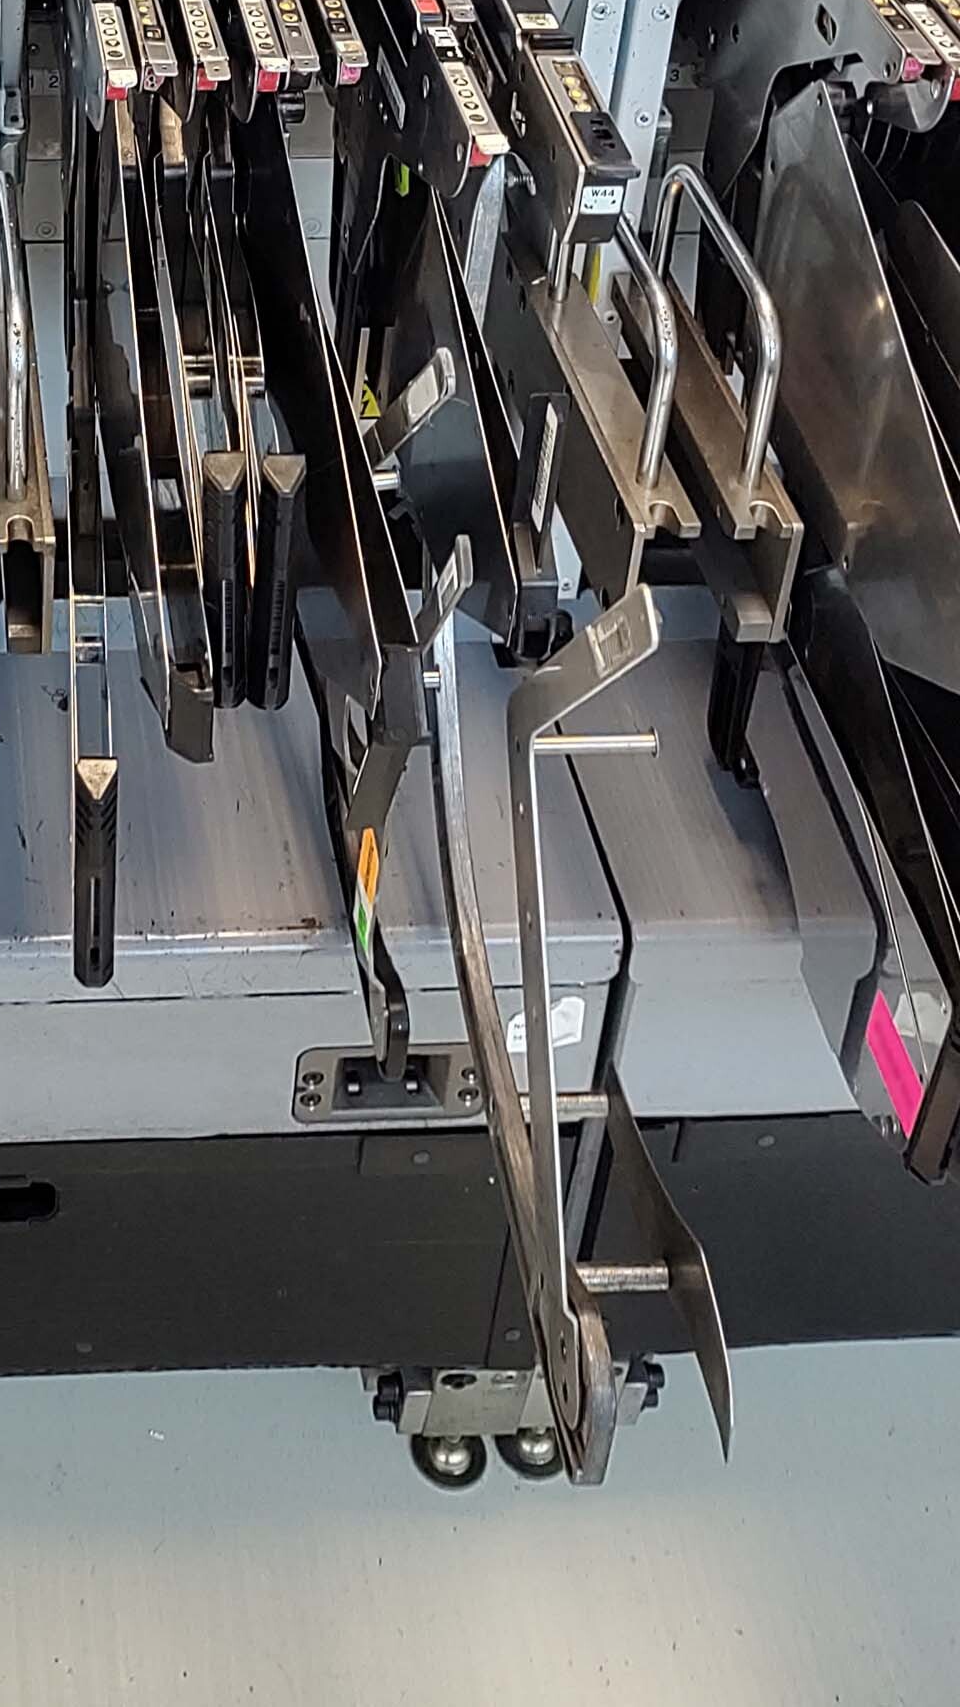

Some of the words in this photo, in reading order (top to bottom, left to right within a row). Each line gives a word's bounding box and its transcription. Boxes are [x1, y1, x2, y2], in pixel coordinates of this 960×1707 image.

[670, 70, 679, 81] 3
[49, 75, 59, 88] 2
[591, 189, 615, 197] W44
